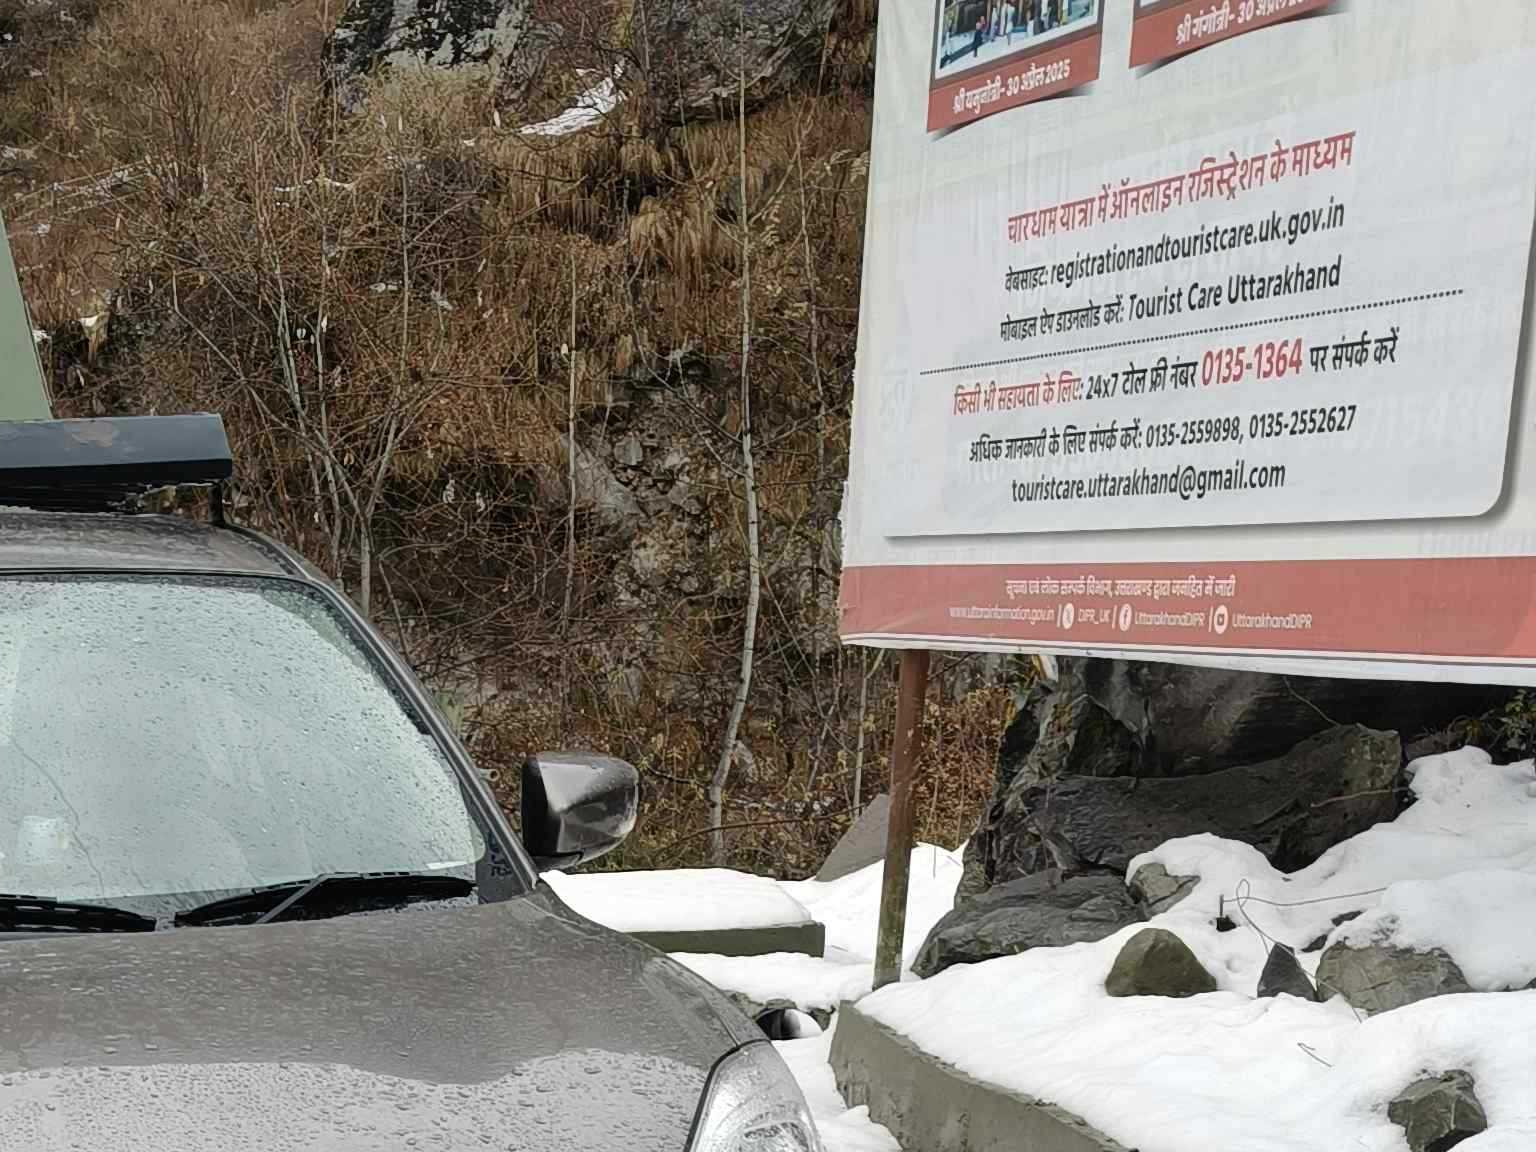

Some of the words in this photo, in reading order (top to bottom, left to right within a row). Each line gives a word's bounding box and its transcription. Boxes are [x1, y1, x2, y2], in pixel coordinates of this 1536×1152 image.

[1175, 13, 1191, 45] श्री
[1006, 76, 1020, 97] 30
[1045, 58, 1071, 84] 2025
[1008, 206, 1058, 243] चारधाम
[1059, 197, 1096, 231] यात्रा
[1097, 183, 1112, 223] में
[1110, 175, 1186, 219] ऑनलाइन
[1188, 151, 1268, 201] रजिस्ट्रेशन
[1270, 139, 1290, 182] के
[1292, 131, 1356, 177] माध्यम
[1050, 195, 1345, 288] registrationandtouristcare.uk.gov.in
[1000, 313, 1039, 342] मोबाइल
[1040, 307, 1055, 335] ऐप
[1056, 299, 1101, 333] डाउनलोड
[1128, 285, 1183, 321] Tourist
[1188, 282, 1223, 311] Care
[1227, 254, 1342, 304] Uttarakhand
[953, 383, 982, 416] किसी
[983, 380, 996, 412] भी
[998, 382, 1041, 411] सहायता
[1042, 373, 1056, 404] के
[1085, 372, 1119, 400] 24x7
[1122, 361, 1148, 395] टोल
[1148, 356, 1169, 393] फ्री
[1170, 355, 1199, 389] नंबर
[1201, 337, 1303, 387] 0135-1364
[1310, 345, 1330, 373] पर
[1332, 330, 1372, 371] संपर्क
[1374, 327, 1400, 364] करें
[969, 433, 1003, 463] अधिक
[1004, 427, 1047, 461] जानकारी
[1048, 426, 1061, 456] के
[1062, 424, 1087, 455] लिए
[1088, 419, 1118, 452] संपर्क
[1146, 415, 1244, 448] 0135-2559898,
[1249, 405, 1357, 439] 0135-2552627
[1012, 459, 1286, 502] touristcare.uttarakhand@gmail.com
